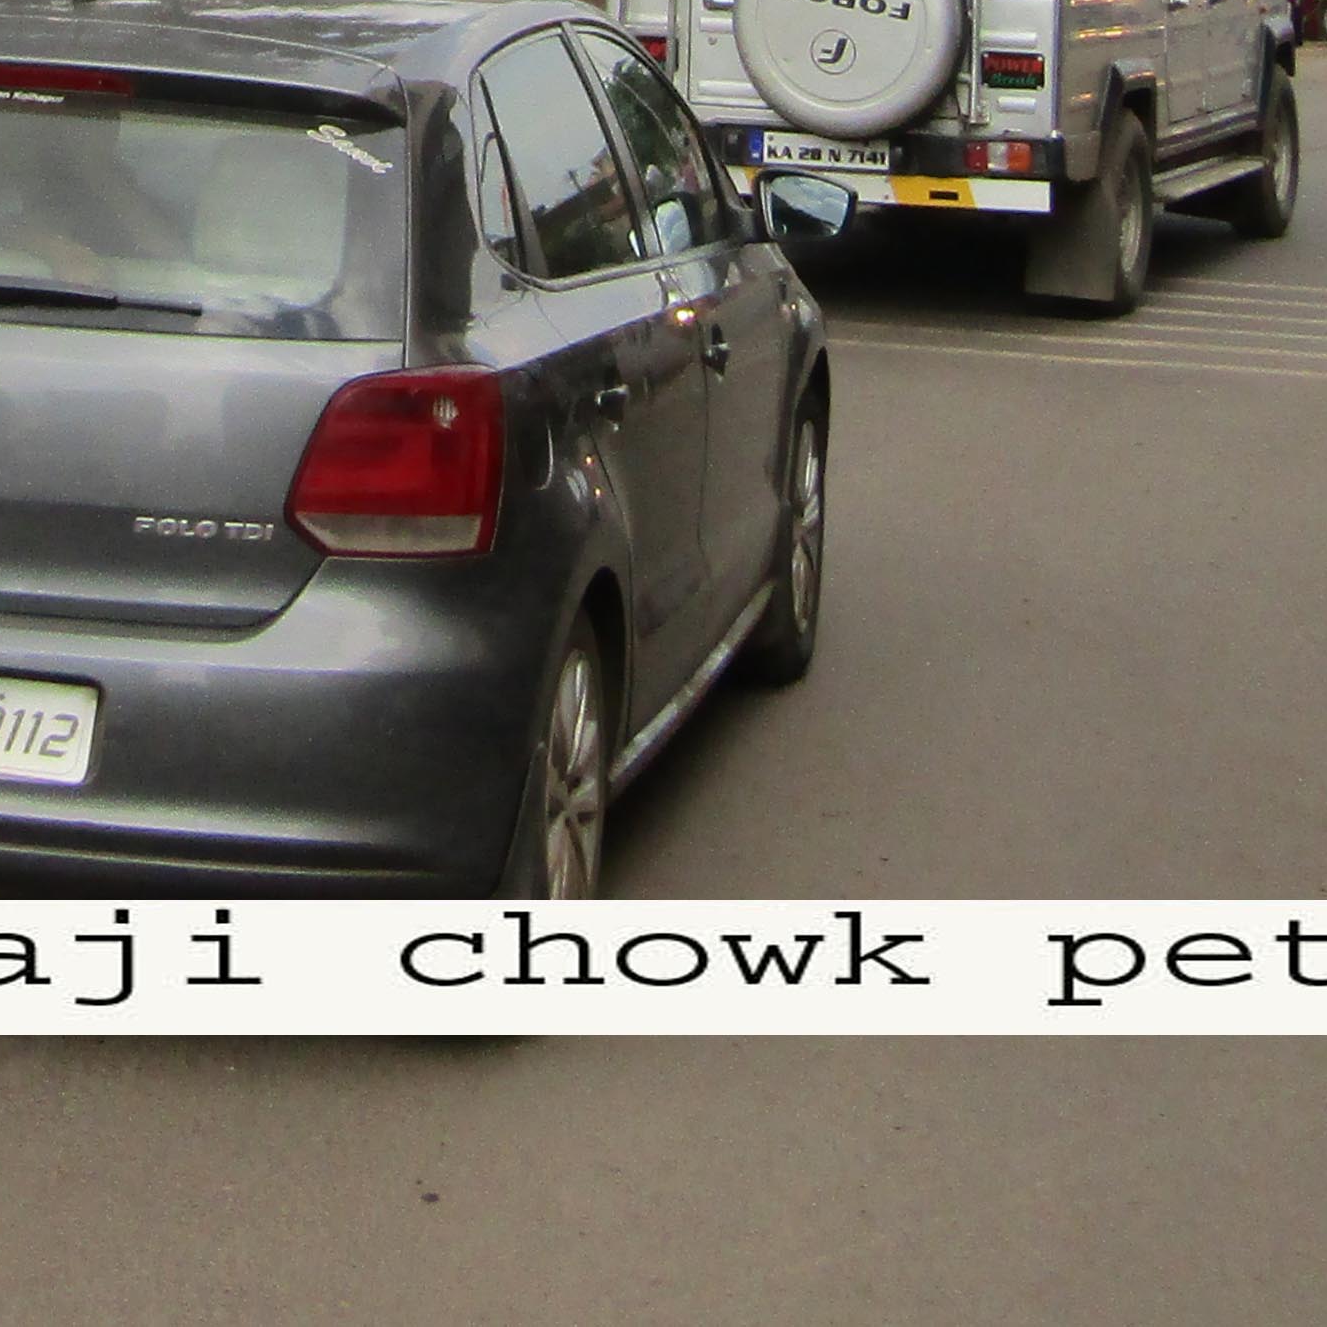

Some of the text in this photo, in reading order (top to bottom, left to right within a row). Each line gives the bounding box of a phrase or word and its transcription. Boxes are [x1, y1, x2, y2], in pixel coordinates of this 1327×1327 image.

[768, 145, 792, 159] KA
[828, 148, 841, 162] N
[134, 516, 274, 541] POLO TDI
